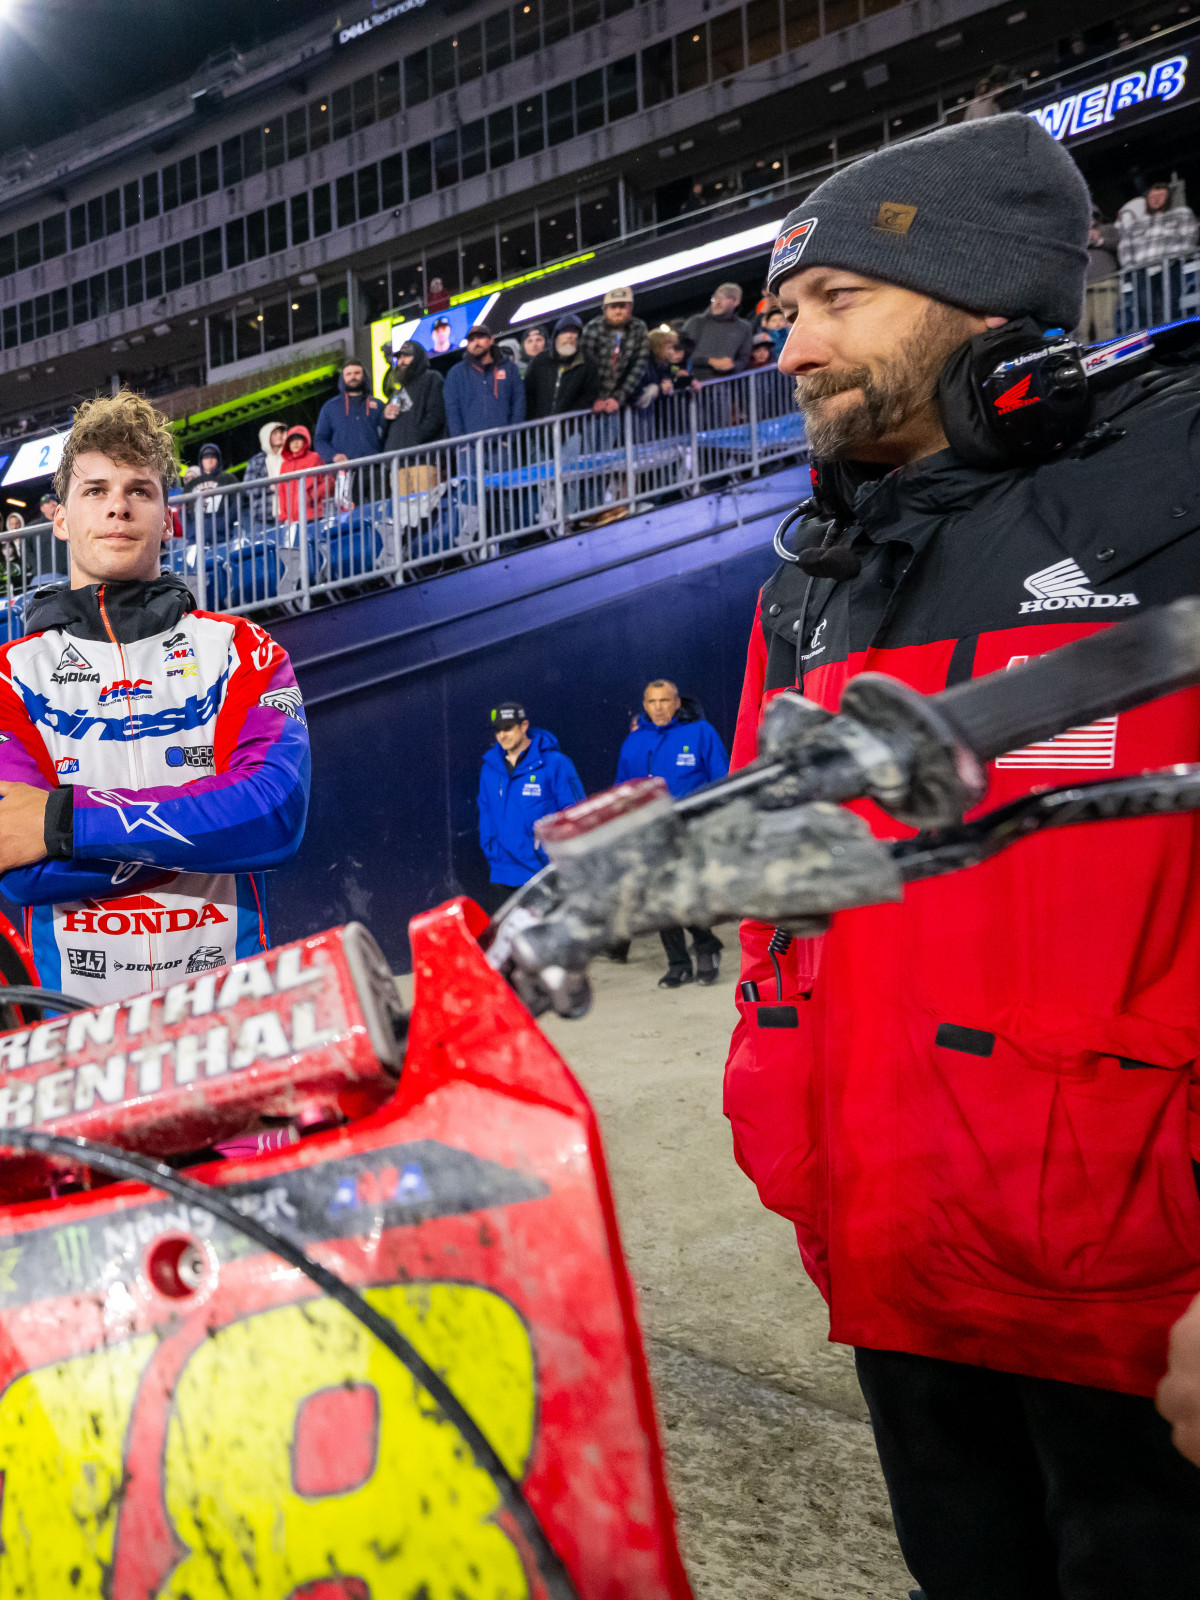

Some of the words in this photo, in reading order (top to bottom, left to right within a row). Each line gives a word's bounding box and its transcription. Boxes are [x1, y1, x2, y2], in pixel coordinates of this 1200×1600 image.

[1026, 55, 1188, 141] WEBB
[1014, 349, 1048, 366] United
[1017, 592, 1140, 614] HONDA
[163, 648, 196, 663] AMA
[50, 672, 100, 685] SHOWA
[98, 678, 153, 703] HRC
[184, 746, 215, 757] QUAD
[62, 902, 229, 936] HONDA
[124, 959, 183, 972] DUNLOP
